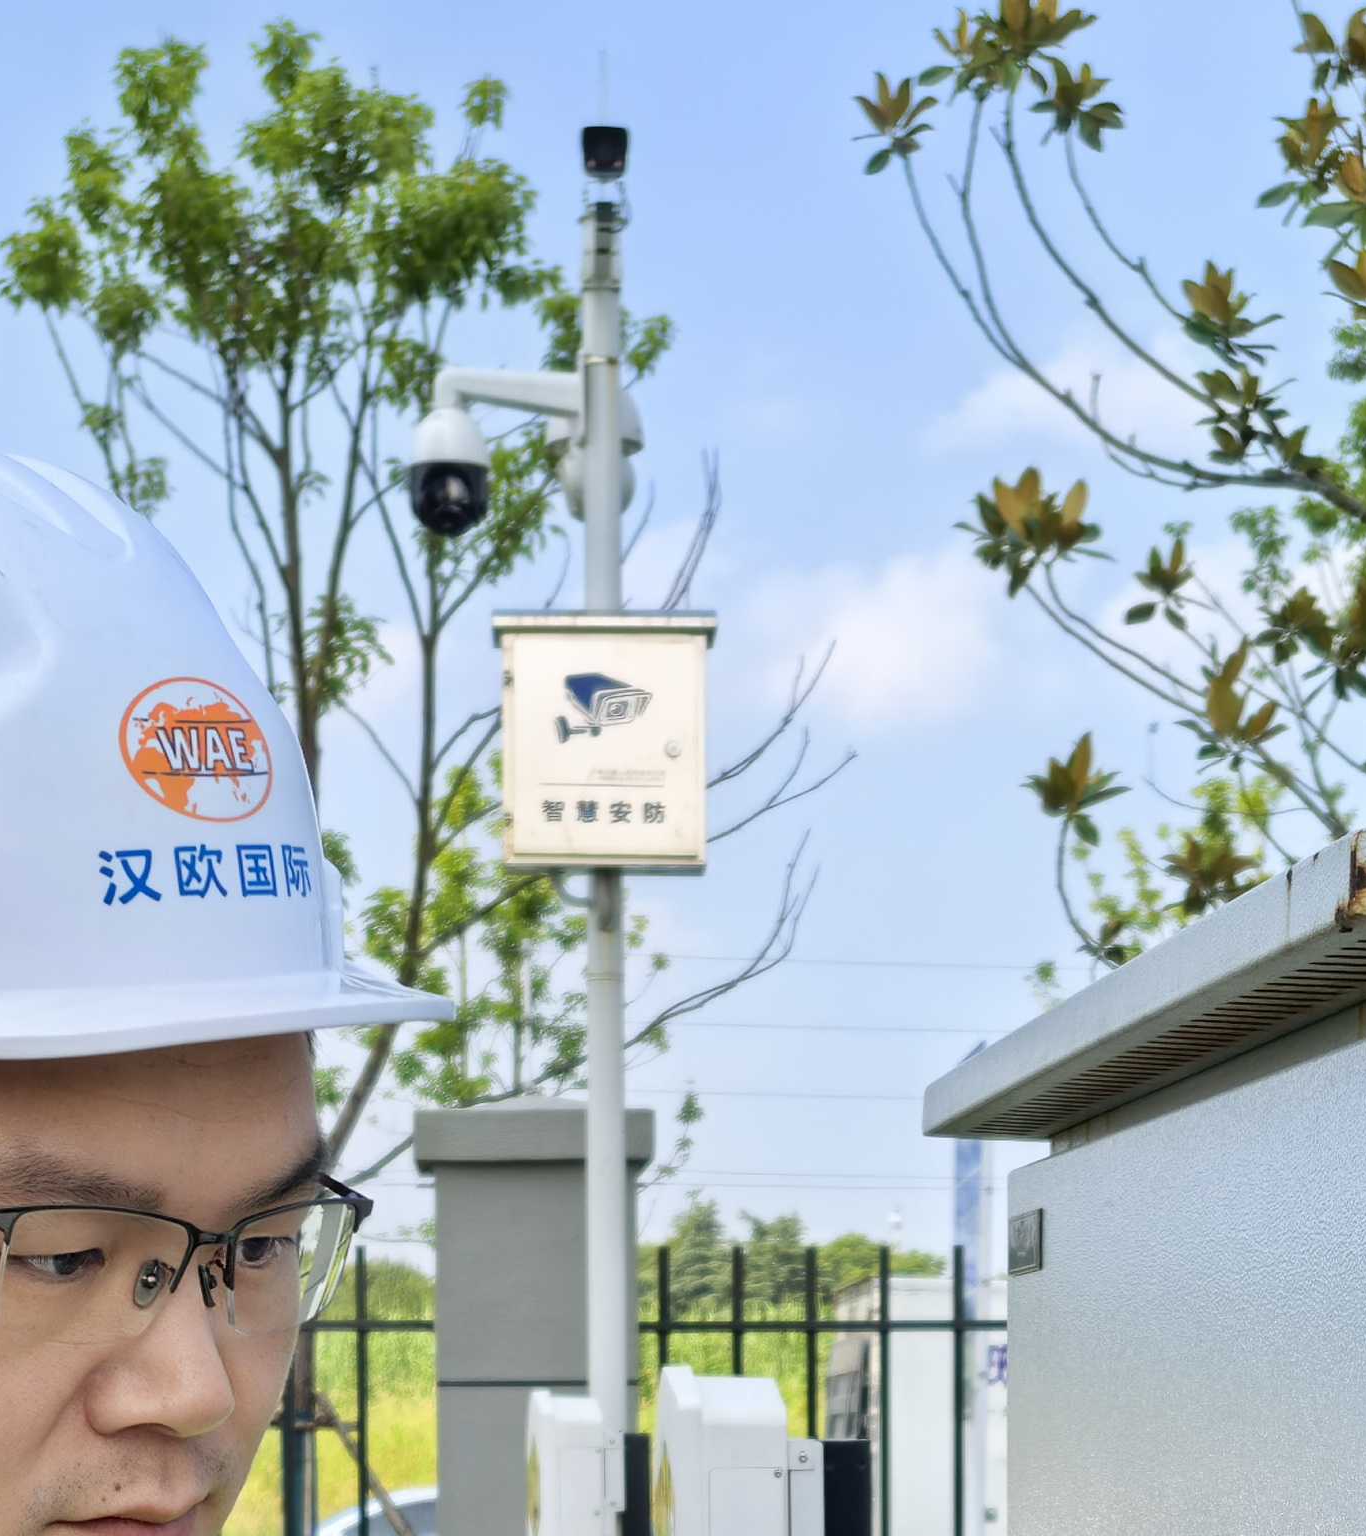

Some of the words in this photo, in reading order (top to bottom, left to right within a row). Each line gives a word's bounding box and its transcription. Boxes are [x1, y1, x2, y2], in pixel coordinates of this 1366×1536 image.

[156, 725, 255, 775] WAE
[541, 799, 667, 824] 智慧安防
[98, 843, 312, 906] 汉欧国际
